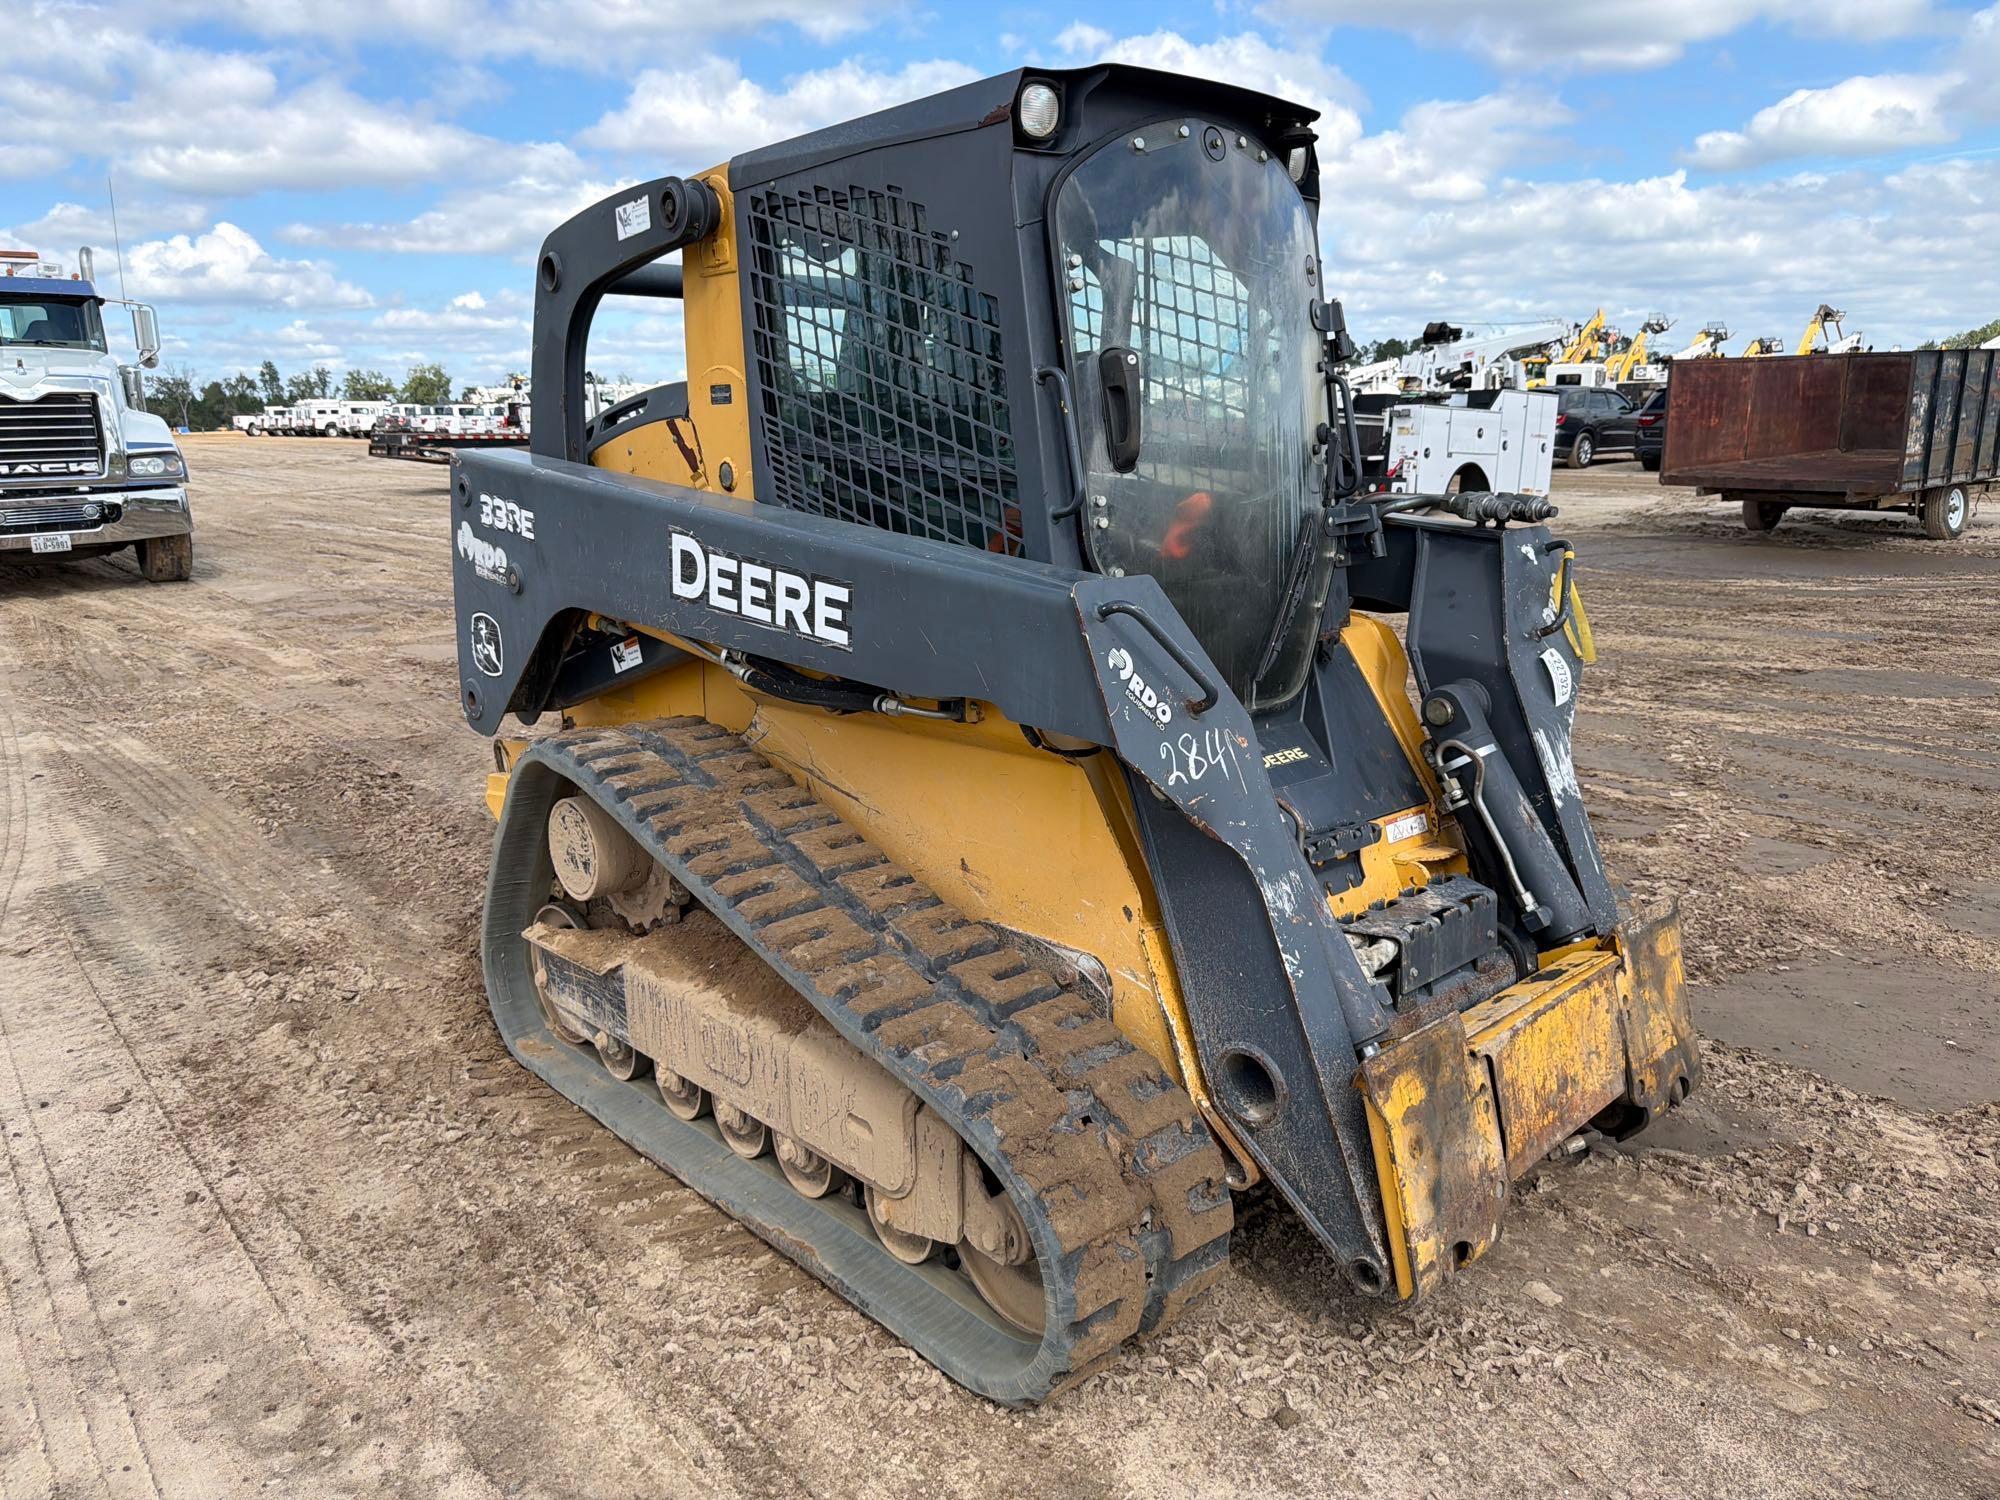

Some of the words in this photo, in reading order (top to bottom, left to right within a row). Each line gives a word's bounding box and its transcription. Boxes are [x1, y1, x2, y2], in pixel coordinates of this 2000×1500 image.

[671, 532, 849, 645] DEERE
[1128, 673, 1172, 724] RDO
[1553, 658, 1569, 697] 227323
[1155, 719, 1166, 731] CO
